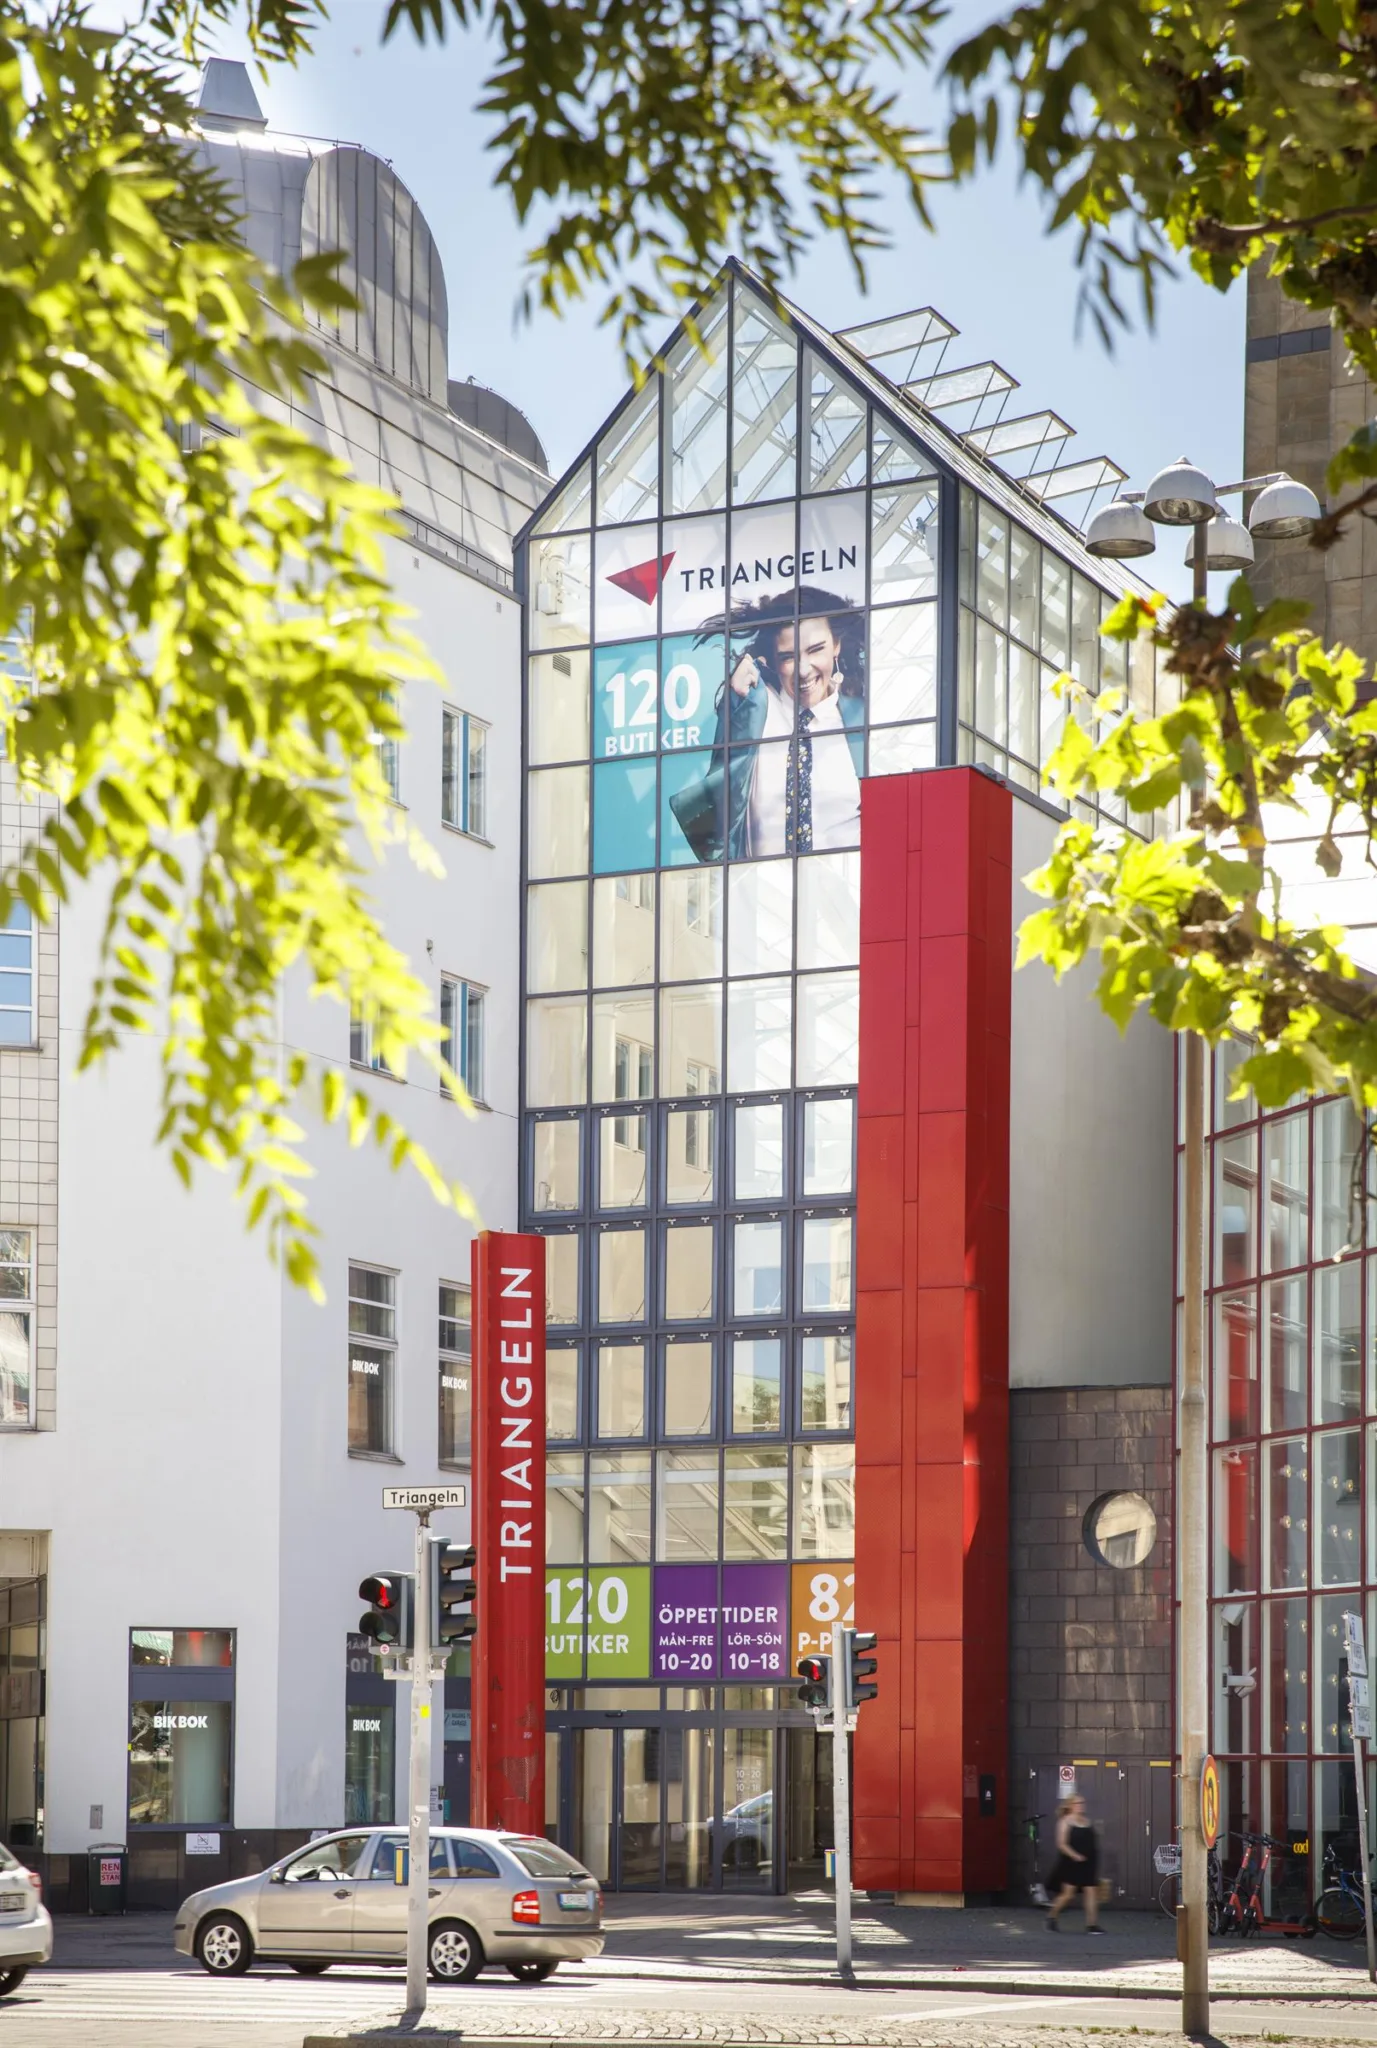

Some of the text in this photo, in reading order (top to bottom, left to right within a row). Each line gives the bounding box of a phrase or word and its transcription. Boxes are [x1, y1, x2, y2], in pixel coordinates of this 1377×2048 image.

[680, 545, 857, 593] TRIANGELN
[605, 663, 701, 729] 120
[605, 726, 701, 757] BUTIKER
[500, 1267, 532, 1583] TRIANGELN
[390, 1489, 458, 1506] Triangeln
[545, 1576, 629, 1624] 120
[101, 1863, 120, 1871] REN
